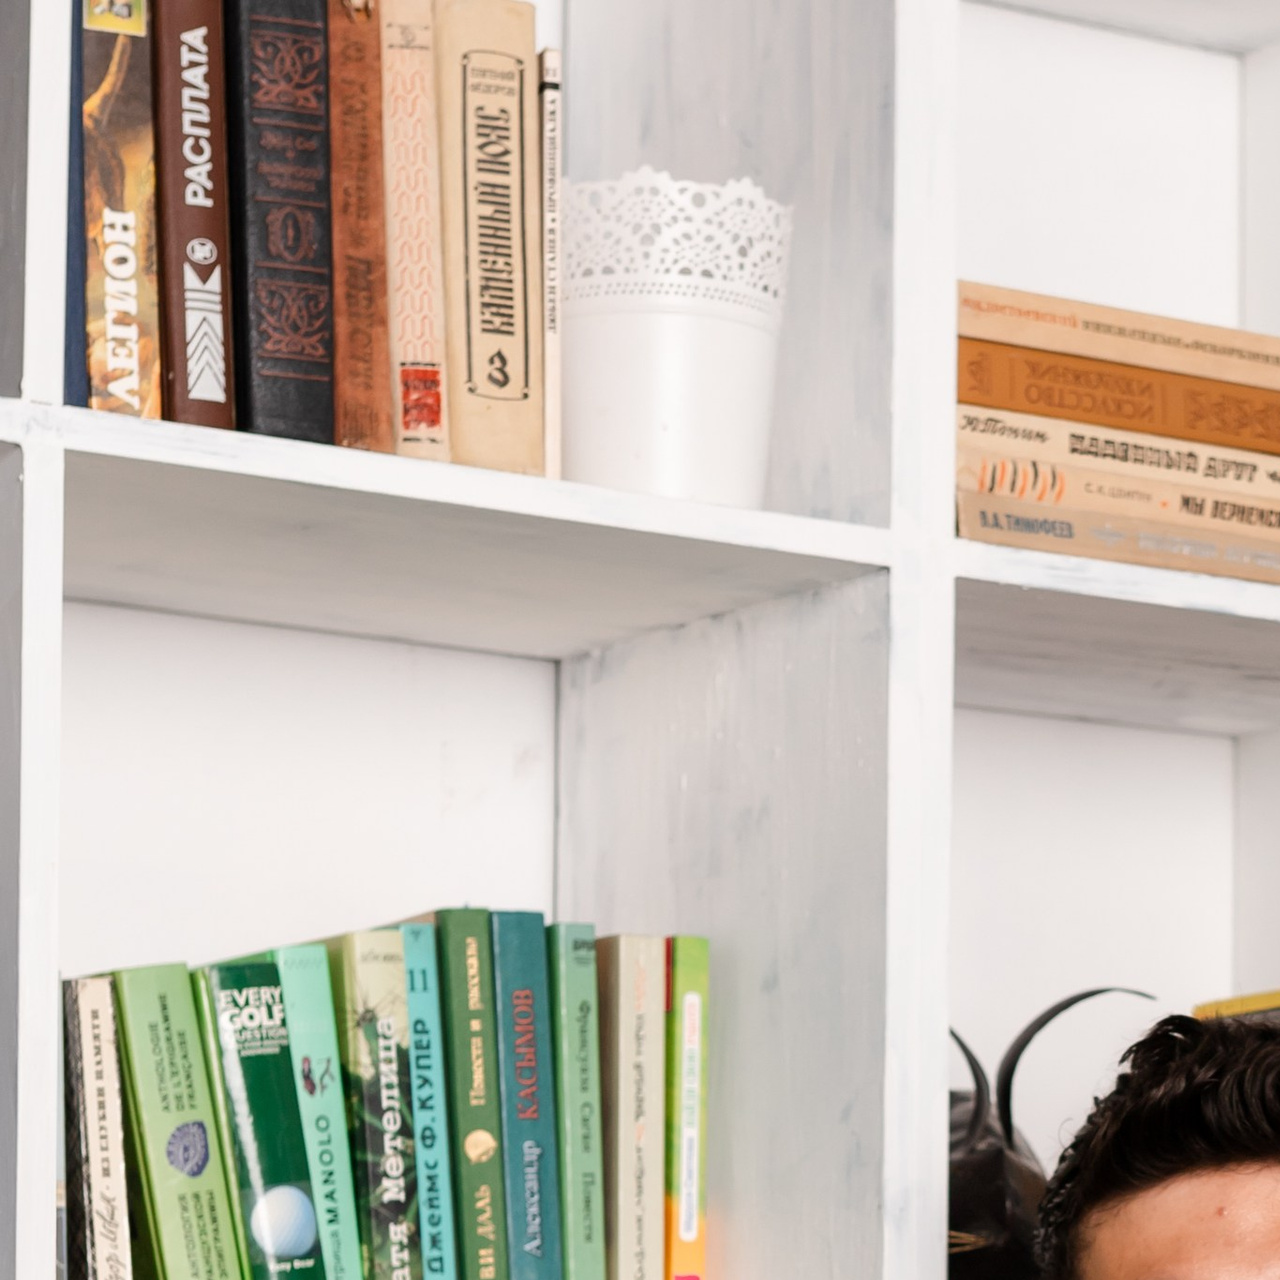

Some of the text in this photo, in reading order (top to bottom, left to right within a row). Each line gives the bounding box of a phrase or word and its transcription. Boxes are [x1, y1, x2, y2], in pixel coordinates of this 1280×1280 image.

[181, 26, 213, 207] РАСПЛАТА
[474, 106, 516, 337] КАМЕННЫЙ ПОЯС
[103, 207, 141, 411] ЛЕГИОН
[488, 348, 511, 389] 3
[220, 985, 282, 1010] EVERY
[221, 1004, 285, 1031] GOLF
[572, 999, 593, 1095] Франсуаза
[376, 1014, 406, 1204] Метелица
[412, 1017, 436, 1113] КУПЕР
[512, 987, 546, 1257] Александр КАСЫМОВ
[315, 1113, 340, 1228] MANOLO
[418, 1157, 446, 1276] Джеймс
[474, 1183, 497, 1242] ДАЛЬ
